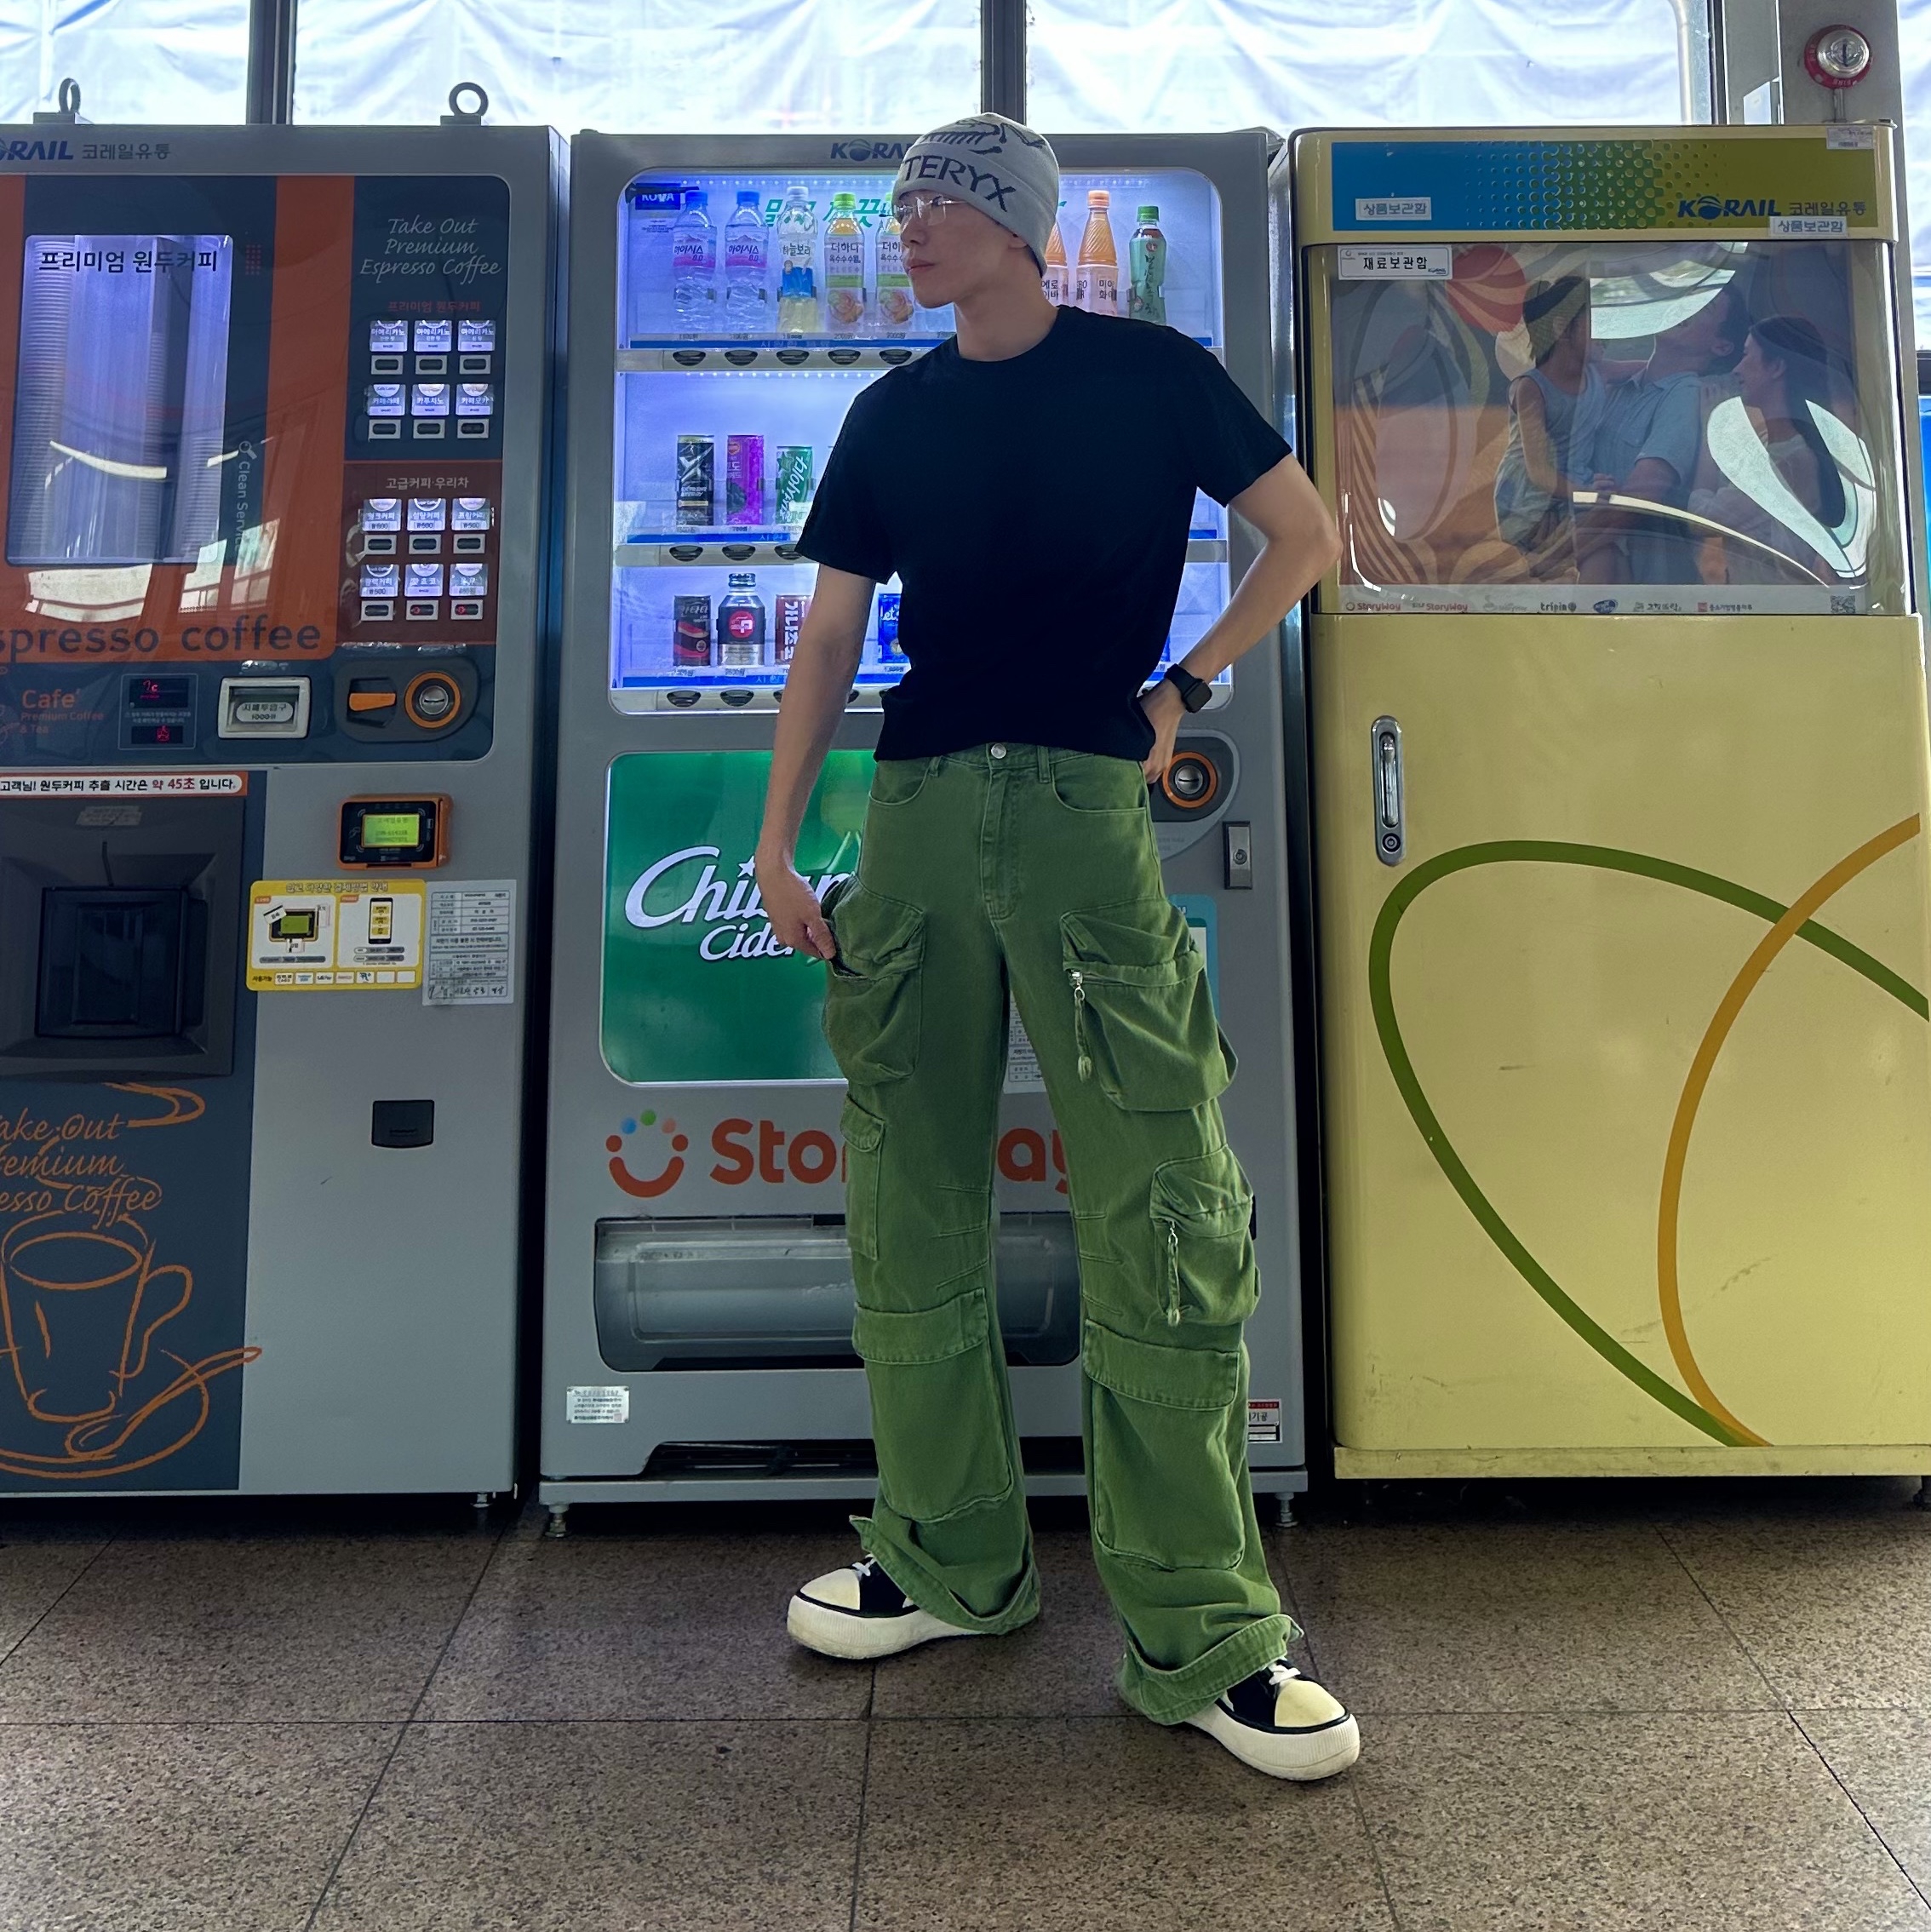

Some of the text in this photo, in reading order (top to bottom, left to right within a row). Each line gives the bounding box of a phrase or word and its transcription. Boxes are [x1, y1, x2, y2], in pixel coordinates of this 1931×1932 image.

[82, 143, 170, 160] 코레일유통
[902, 154, 1017, 213] TERYX
[1678, 196, 1781, 220] KORAIL
[1790, 201, 1866, 216] 코레일유통
[387, 215, 479, 235] Take Out
[1778, 220, 1843, 233] 상품보관함
[385, 237, 480, 255] Premium
[831, 242, 858, 253] 더하다
[39, 250, 217, 273] 프리미엄 원두커피
[360, 255, 502, 285] Espresso Coffee
[1363, 256, 1427, 271] 재료보관함
[388, 301, 480, 312] 프리미엄 원두커피
[238, 461, 250, 499] Clean
[181, 614, 321, 653] coffee
[21, 712, 104, 722] Premium Coffee
[30, 725, 49, 734] Tea
[1, 780, 37, 792] 고객님!
[40, 779, 84, 792] 원두커피
[89, 779, 111, 791] 추출
[114, 778, 148, 791] 시간은
[152, 779, 164, 790] 약
[168, 777, 196, 790] 45초
[61, 1114, 126, 1139] Out
[64, 1177, 162, 1230] Coffee
